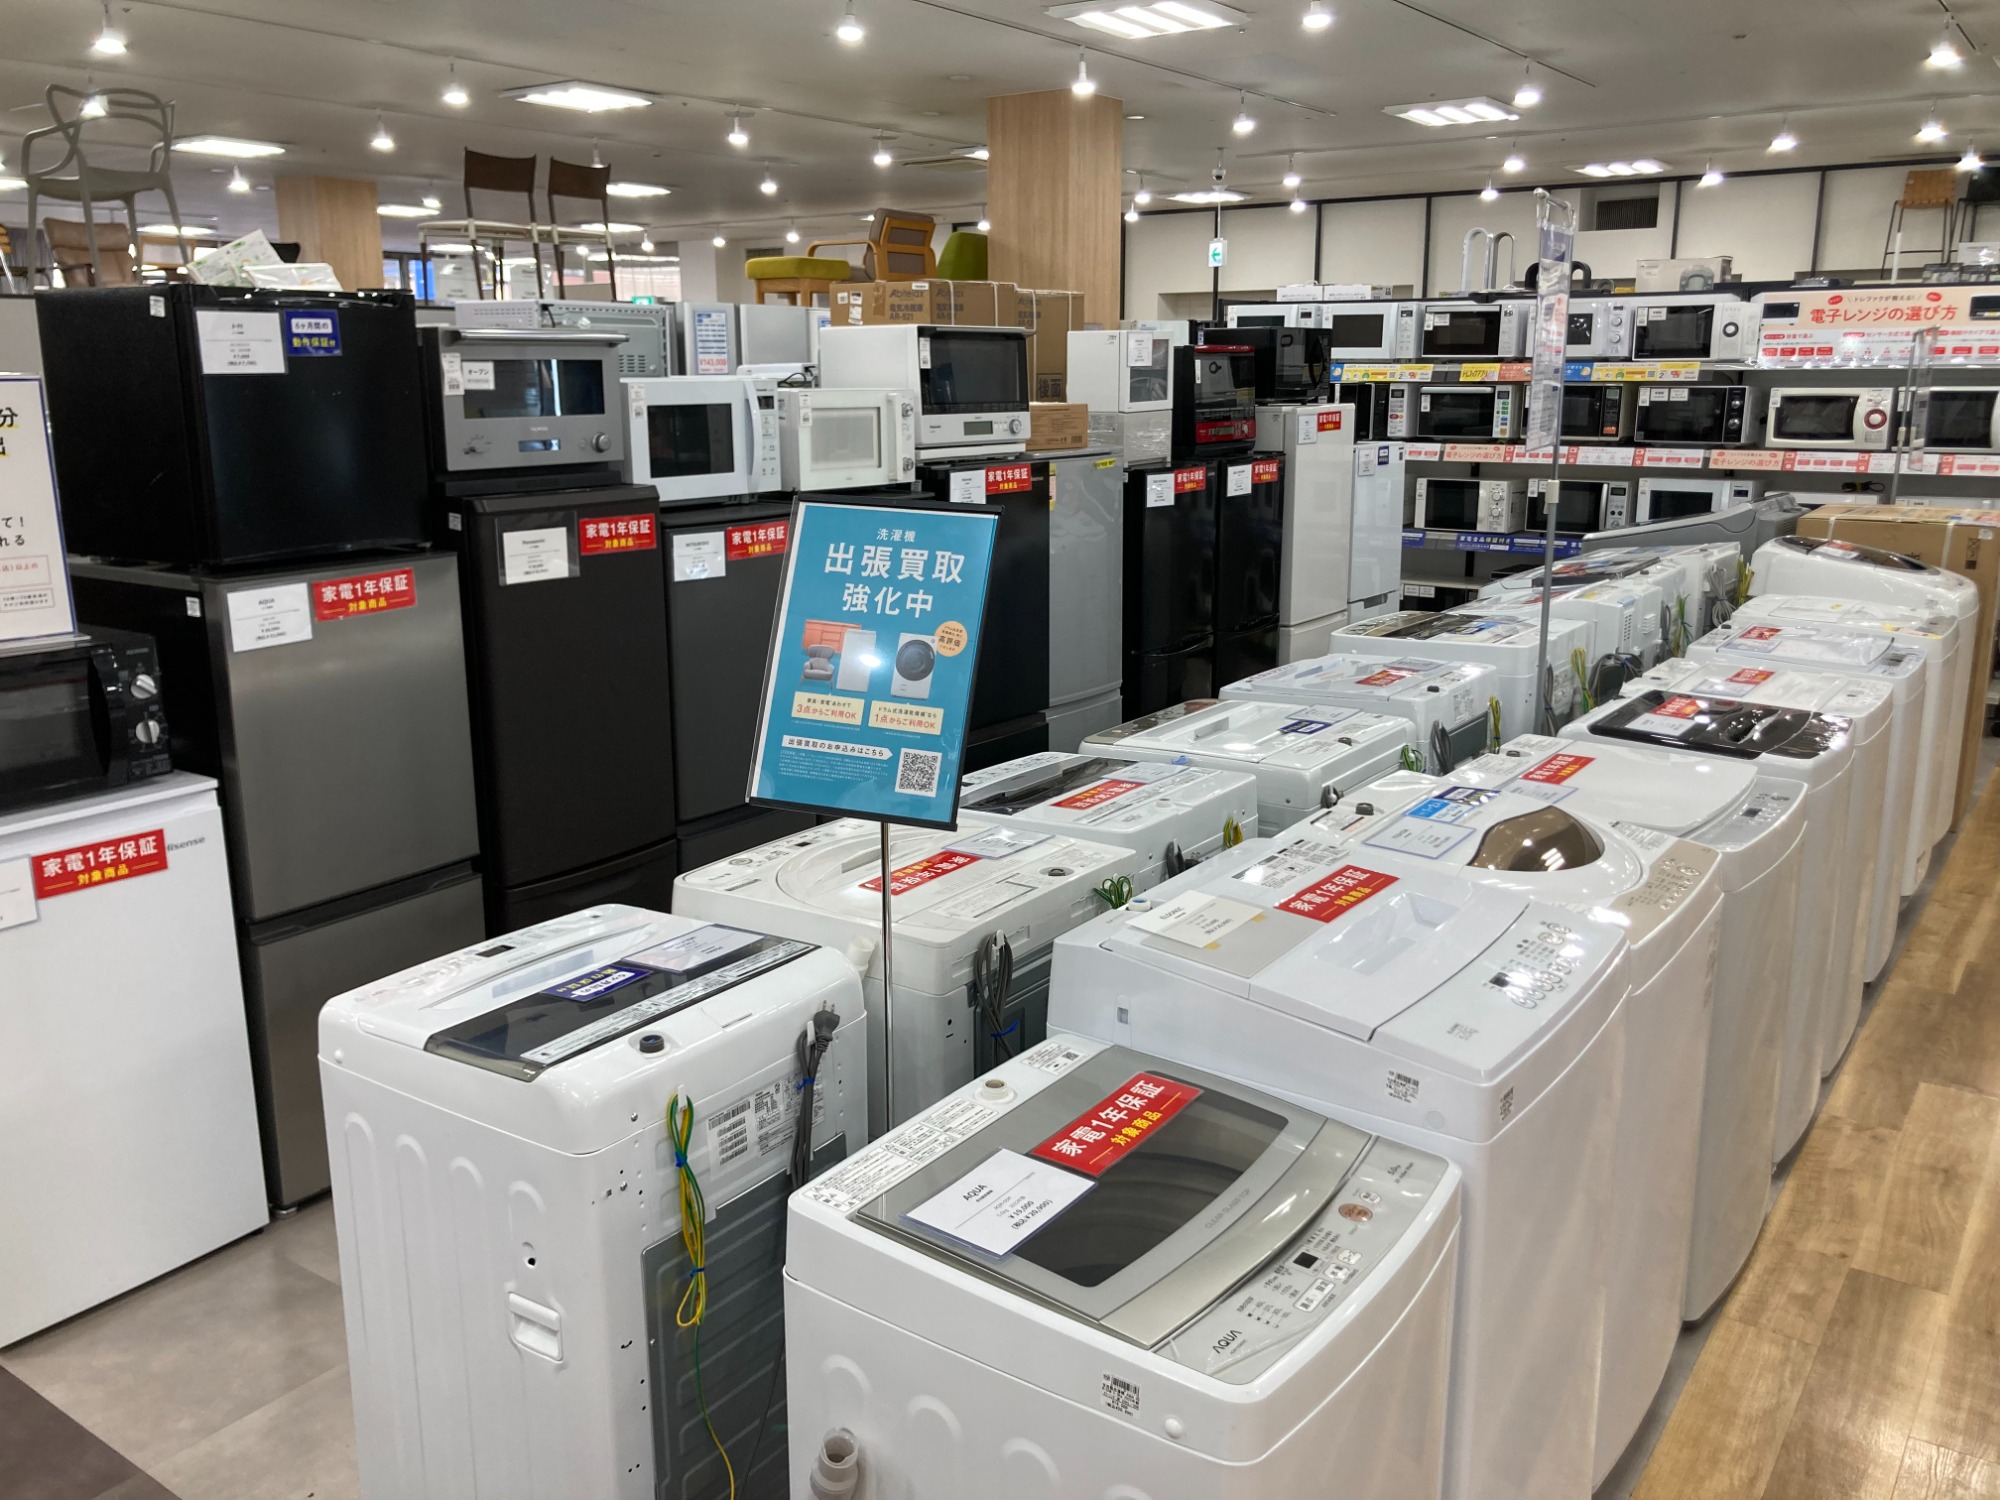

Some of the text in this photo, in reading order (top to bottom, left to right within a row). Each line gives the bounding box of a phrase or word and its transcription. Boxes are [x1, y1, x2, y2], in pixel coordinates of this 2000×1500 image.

[1809, 304, 1958, 324] 電子レンジの選び方
[1712, 458, 1780, 467] 電子レンジの選び方
[987, 468, 1029, 482] 家電1年保証
[585, 518, 650, 539] 家電1年保証
[731, 525, 785, 546] 家電1年保証
[876, 528, 916, 543] 洗濯機
[824, 542, 966, 584] 出張買取
[322, 575, 409, 603] 家電1年保証
[348, 597, 387, 613] 対象商品
[842, 582, 934, 619] 強化中
[796, 704, 857, 720] 3点からご利用OK
[875, 714, 936, 730] 1点からご利用OK
[788, 738, 884, 757] 出張買取のお申込みはこちら
[42, 836, 158, 878] 家電1年保証
[77, 863, 130, 886] 対象商品
[1289, 868, 1372, 912] 家電1年保証
[1051, 1080, 1165, 1157] 家電1年保証
[1110, 1110, 1163, 1147] 対象商品
[962, 1183, 987, 1202] AQUA
[1212, 1329, 1243, 1354] AQUA
